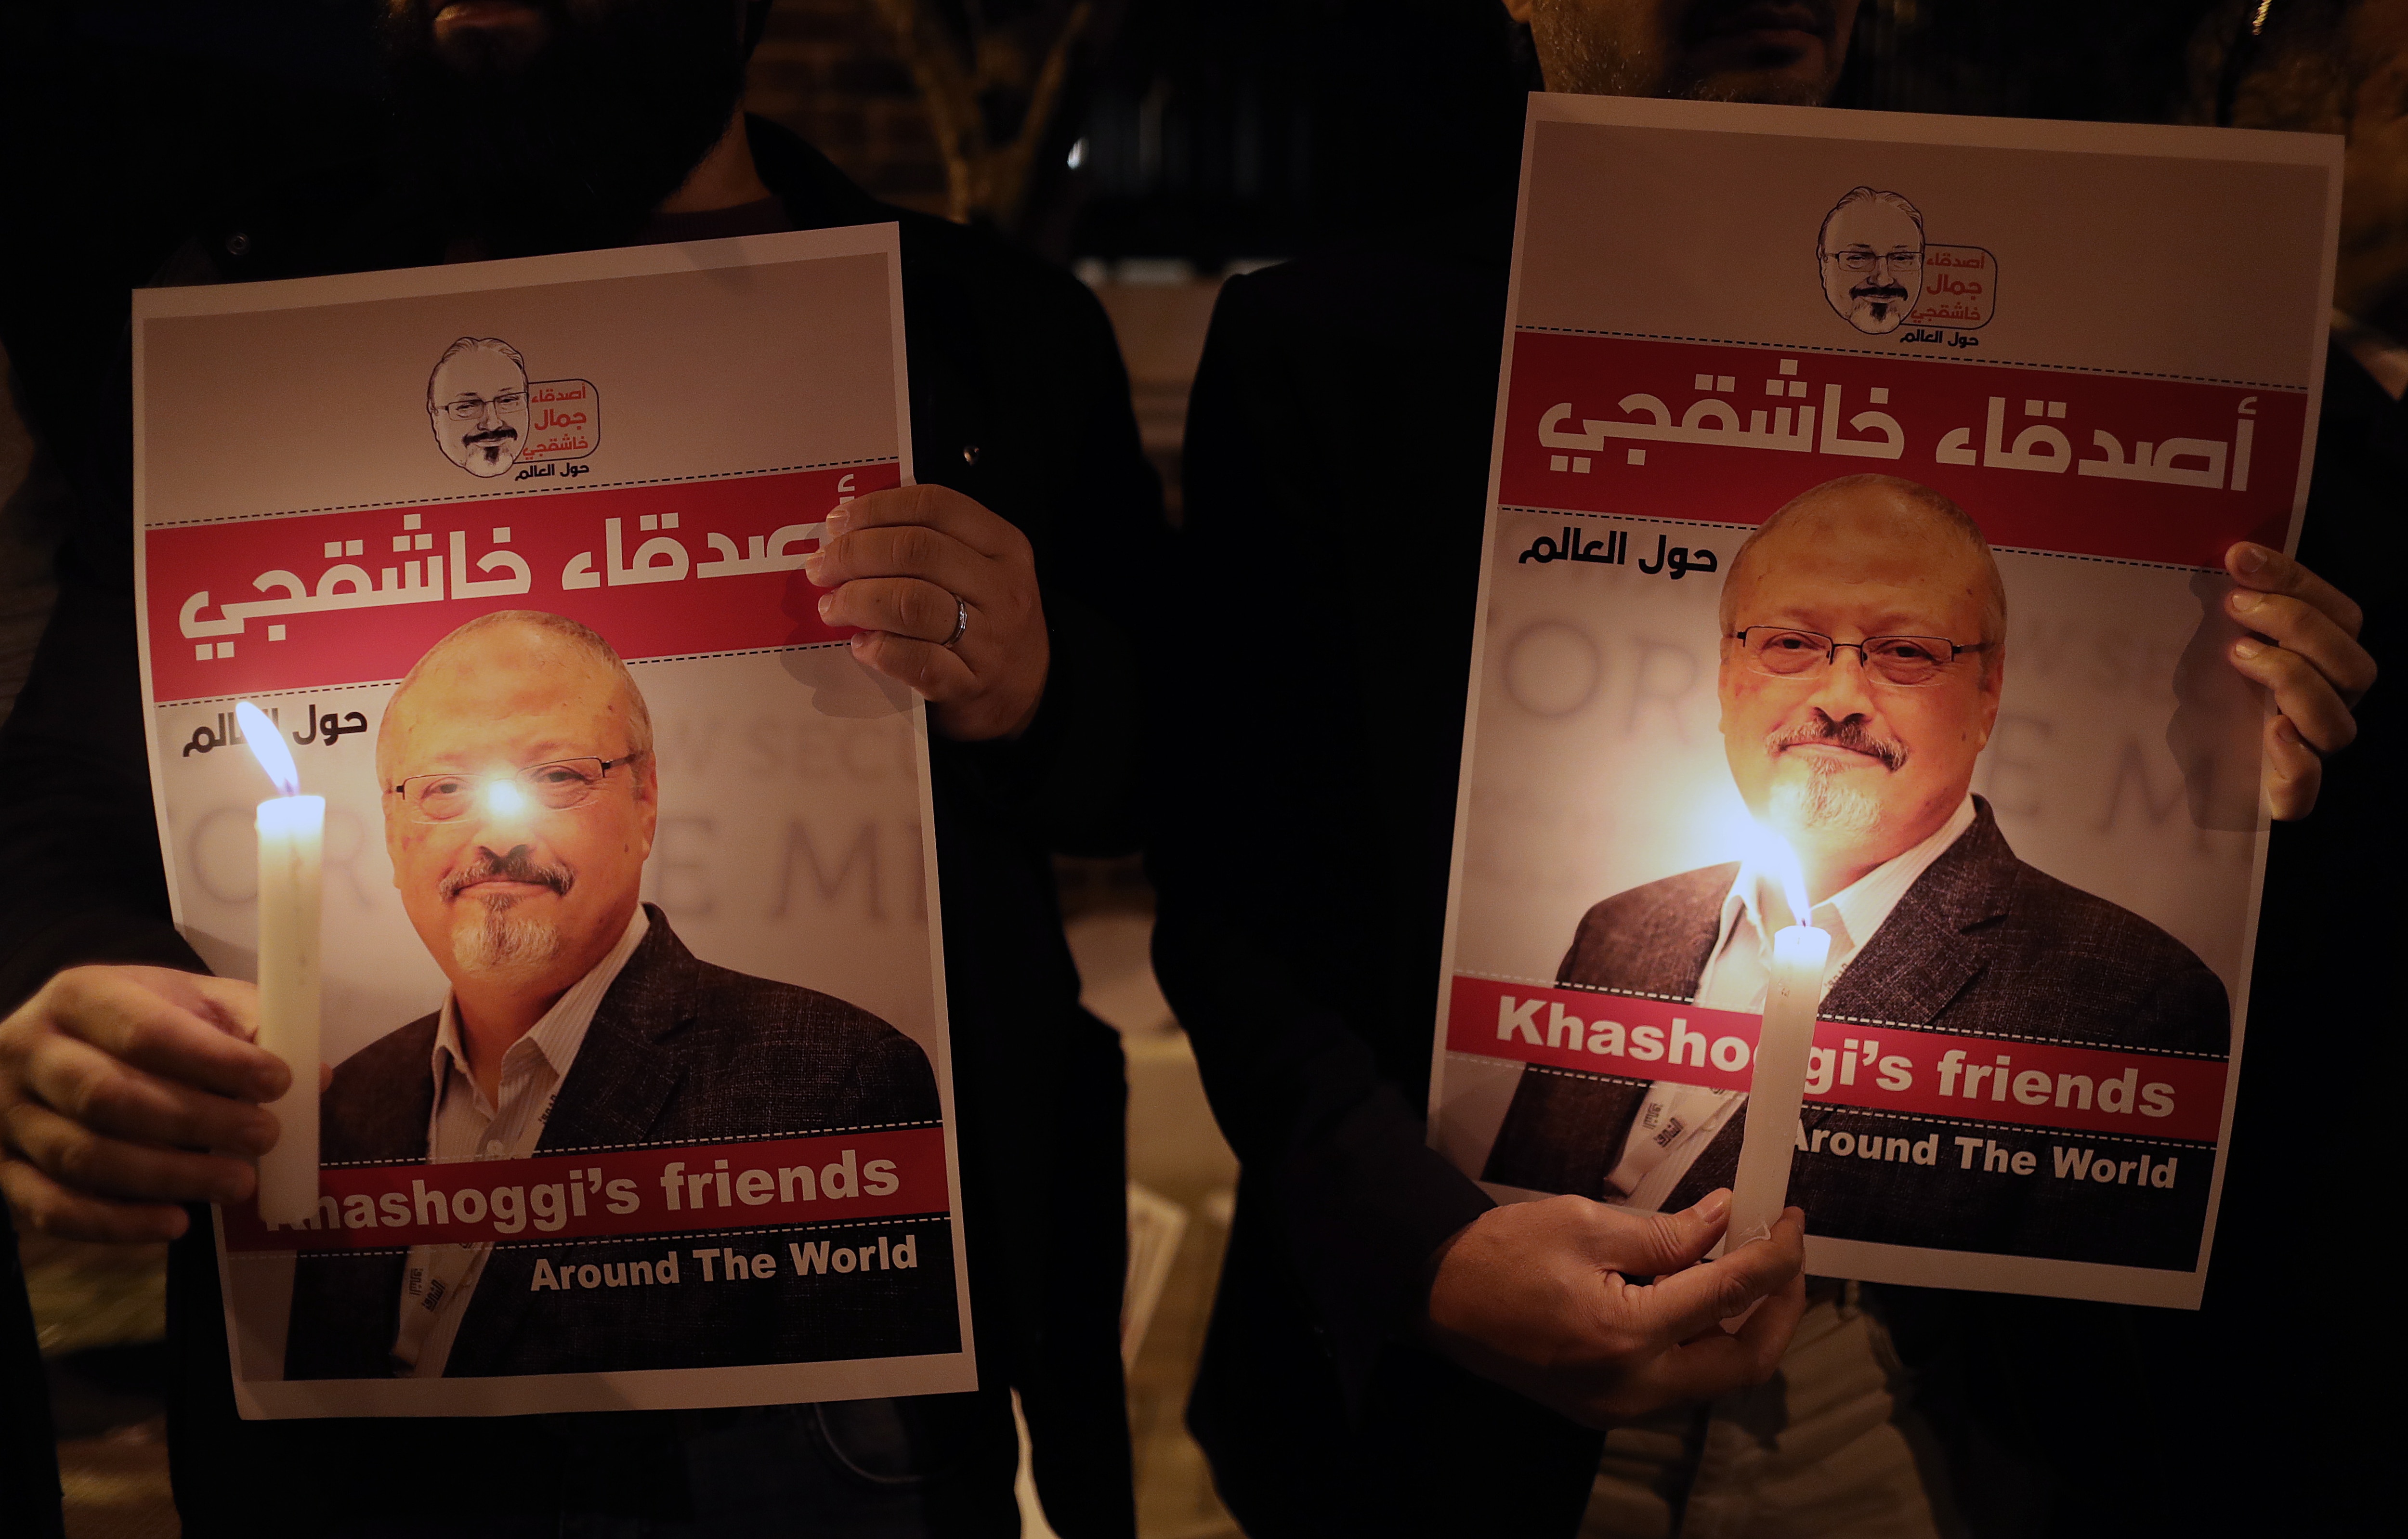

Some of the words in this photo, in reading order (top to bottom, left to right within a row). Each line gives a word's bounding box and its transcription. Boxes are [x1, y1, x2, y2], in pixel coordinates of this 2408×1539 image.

[1926, 251, 1985, 269] أصدقاء
[1926, 274, 1982, 300] جمال
[1911, 301, 1981, 323] خاشقجي
[1899, 329, 1943, 343] العالم
[1947, 332, 1979, 348] حول
[531, 382, 586, 404] أصدقاء
[534, 408, 587, 430] جمال
[1538, 358, 1905, 474] خاشقجي
[522, 433, 589, 460] خاشقجي
[1935, 395, 2258, 492] أصدقاء
[514, 463, 555, 482] العالم
[560, 462, 589, 477] حول
[562, 473, 855, 590] صدقاء
[1518, 526, 1628, 564] العالم
[1638, 535, 1718, 579] حول
[178, 513, 531, 661] خاشقجي
[292, 704, 368, 746] حول
[1496, 995, 1913, 1095] Khashogi’s
[1937, 1049, 2176, 1118] friends
[1954, 1136, 2037, 1176] The
[2053, 1145, 2178, 1190] World
[266, 1166, 641, 1234] hashoggi’s
[660, 1149, 900, 1211] friends
[529, 1251, 681, 1292] Around
[692, 1248, 777, 1282] The
[789, 1234, 918, 1277] World
